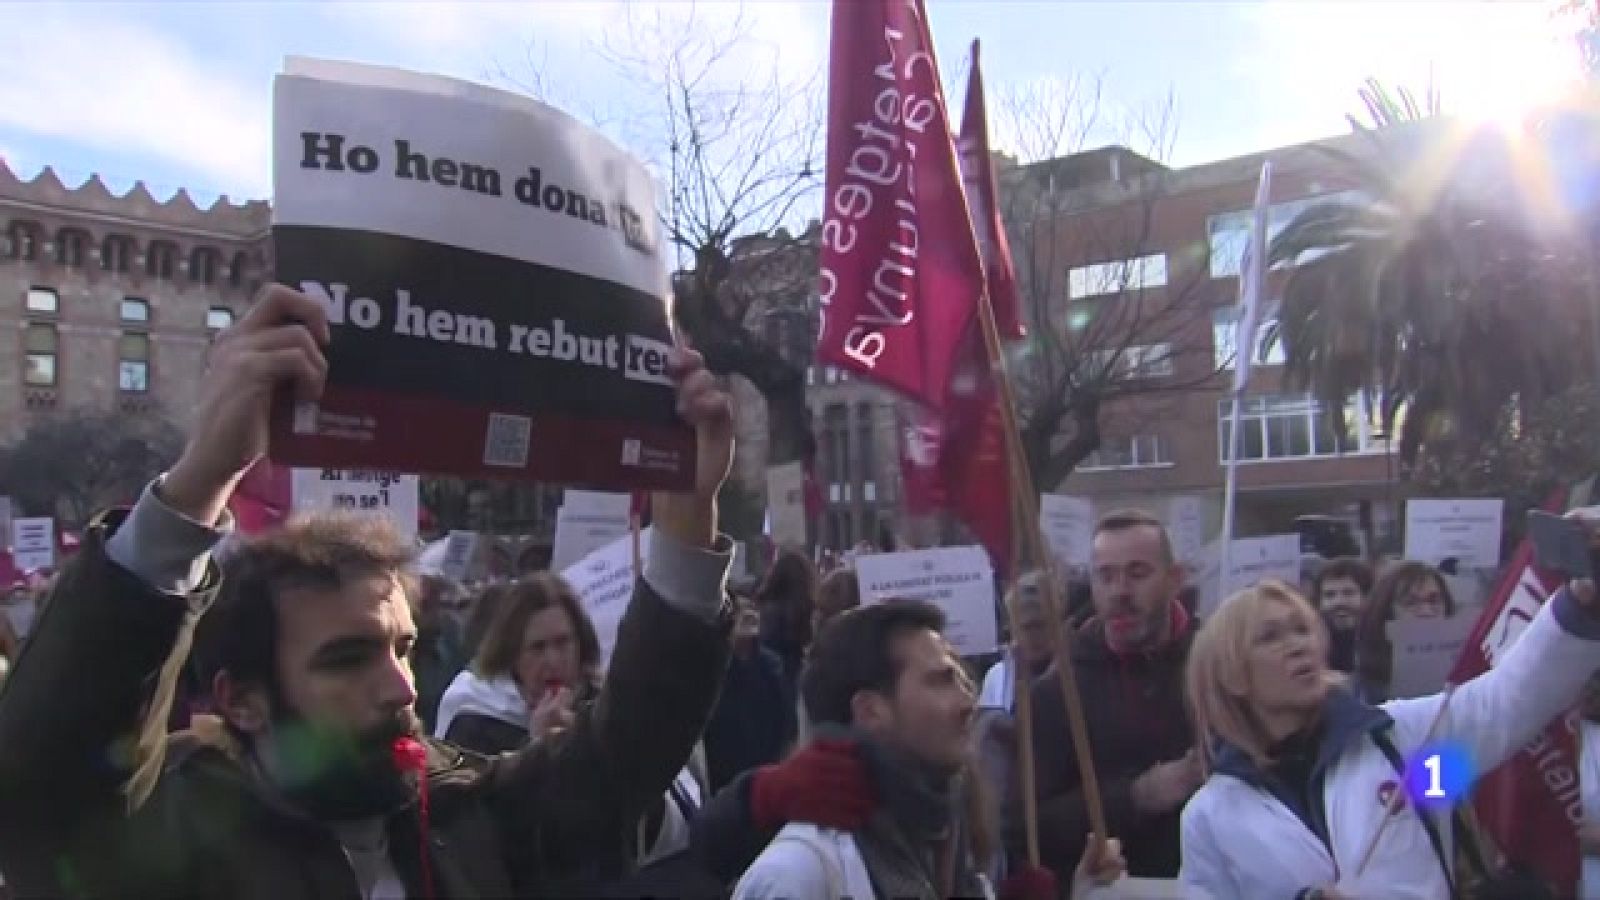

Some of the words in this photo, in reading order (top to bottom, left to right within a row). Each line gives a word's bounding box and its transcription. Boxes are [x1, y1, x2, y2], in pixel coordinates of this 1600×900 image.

[300, 132, 380, 173] Ho
[395, 140, 502, 198] hem
[514, 167, 618, 230] dona
[299, 281, 381, 329] No
[393, 288, 496, 350] hem
[507, 319, 619, 370] rebut
